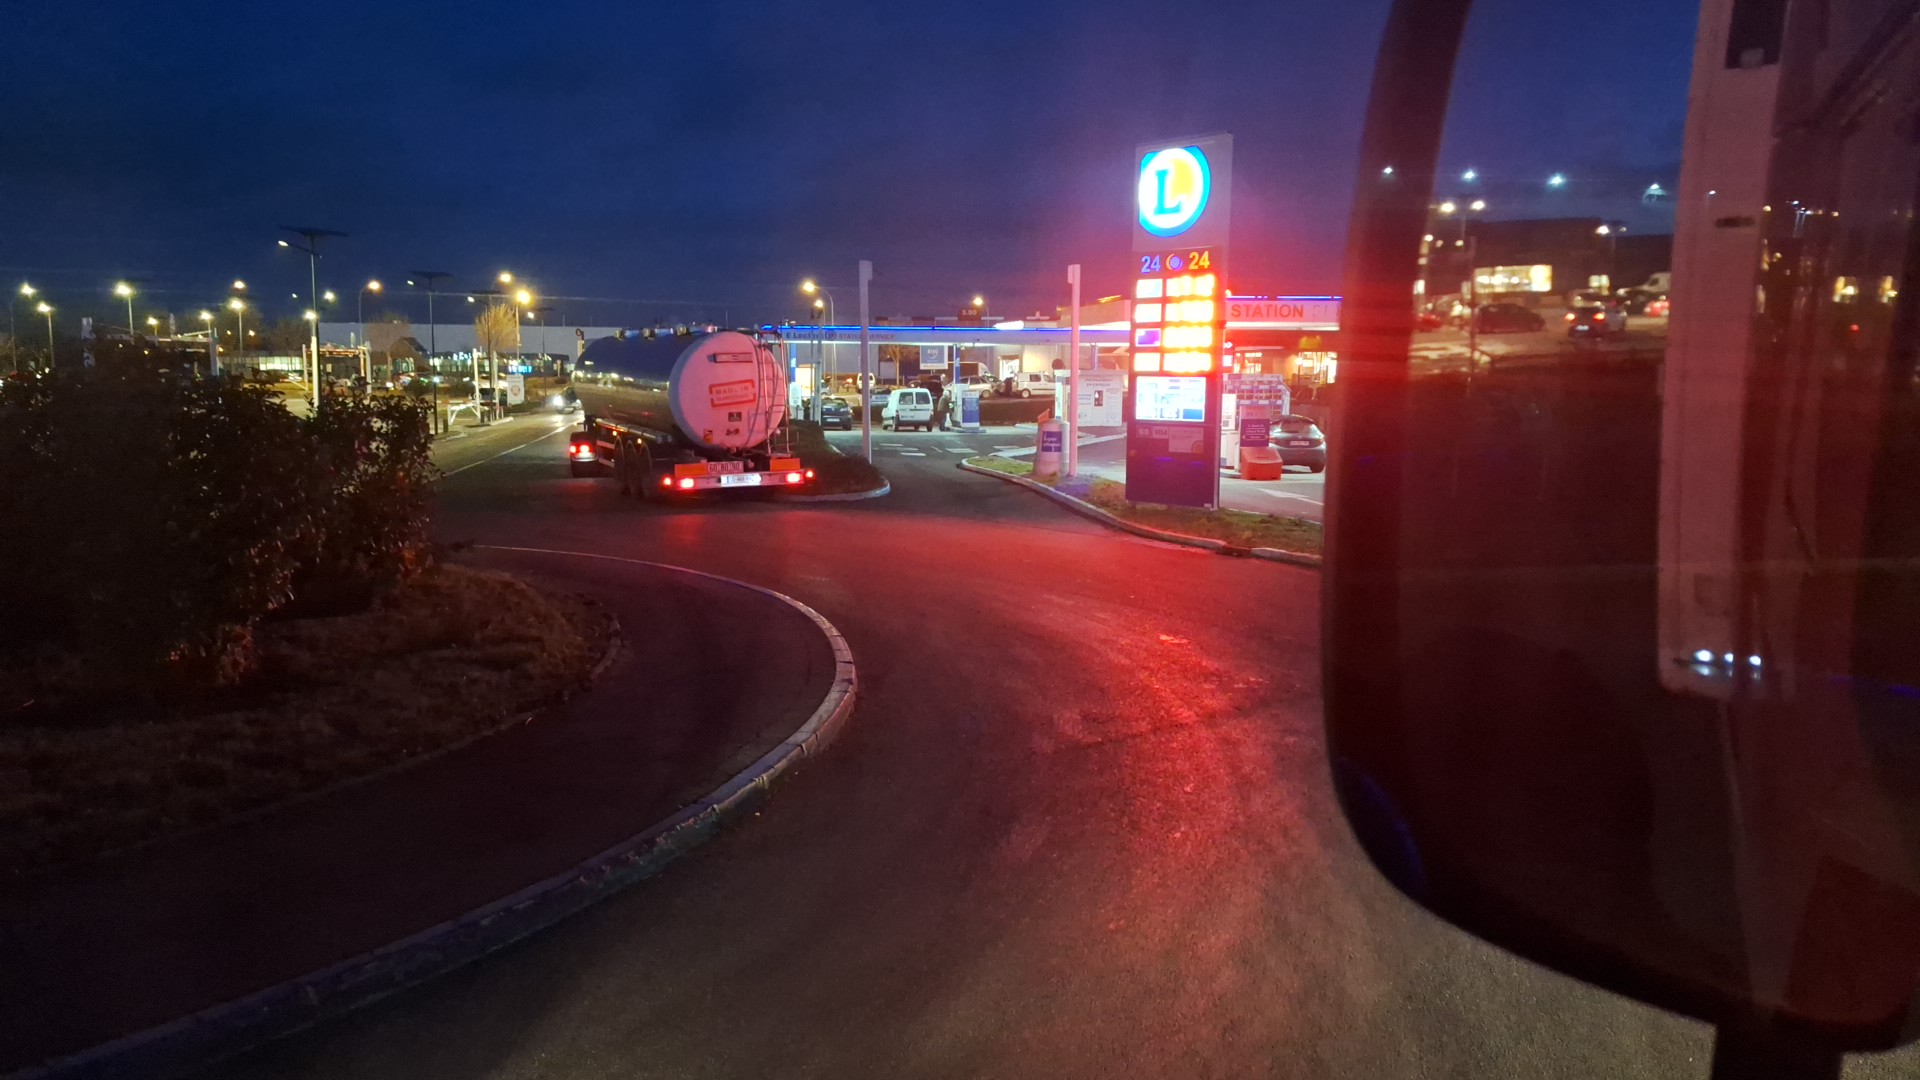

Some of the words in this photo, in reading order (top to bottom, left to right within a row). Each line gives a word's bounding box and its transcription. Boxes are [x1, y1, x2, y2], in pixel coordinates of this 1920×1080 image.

[1154, 168, 1183, 216] L
[1141, 255, 1161, 273] 24
[1189, 251, 1210, 270] 24
[1231, 303, 1304, 318] STATION
